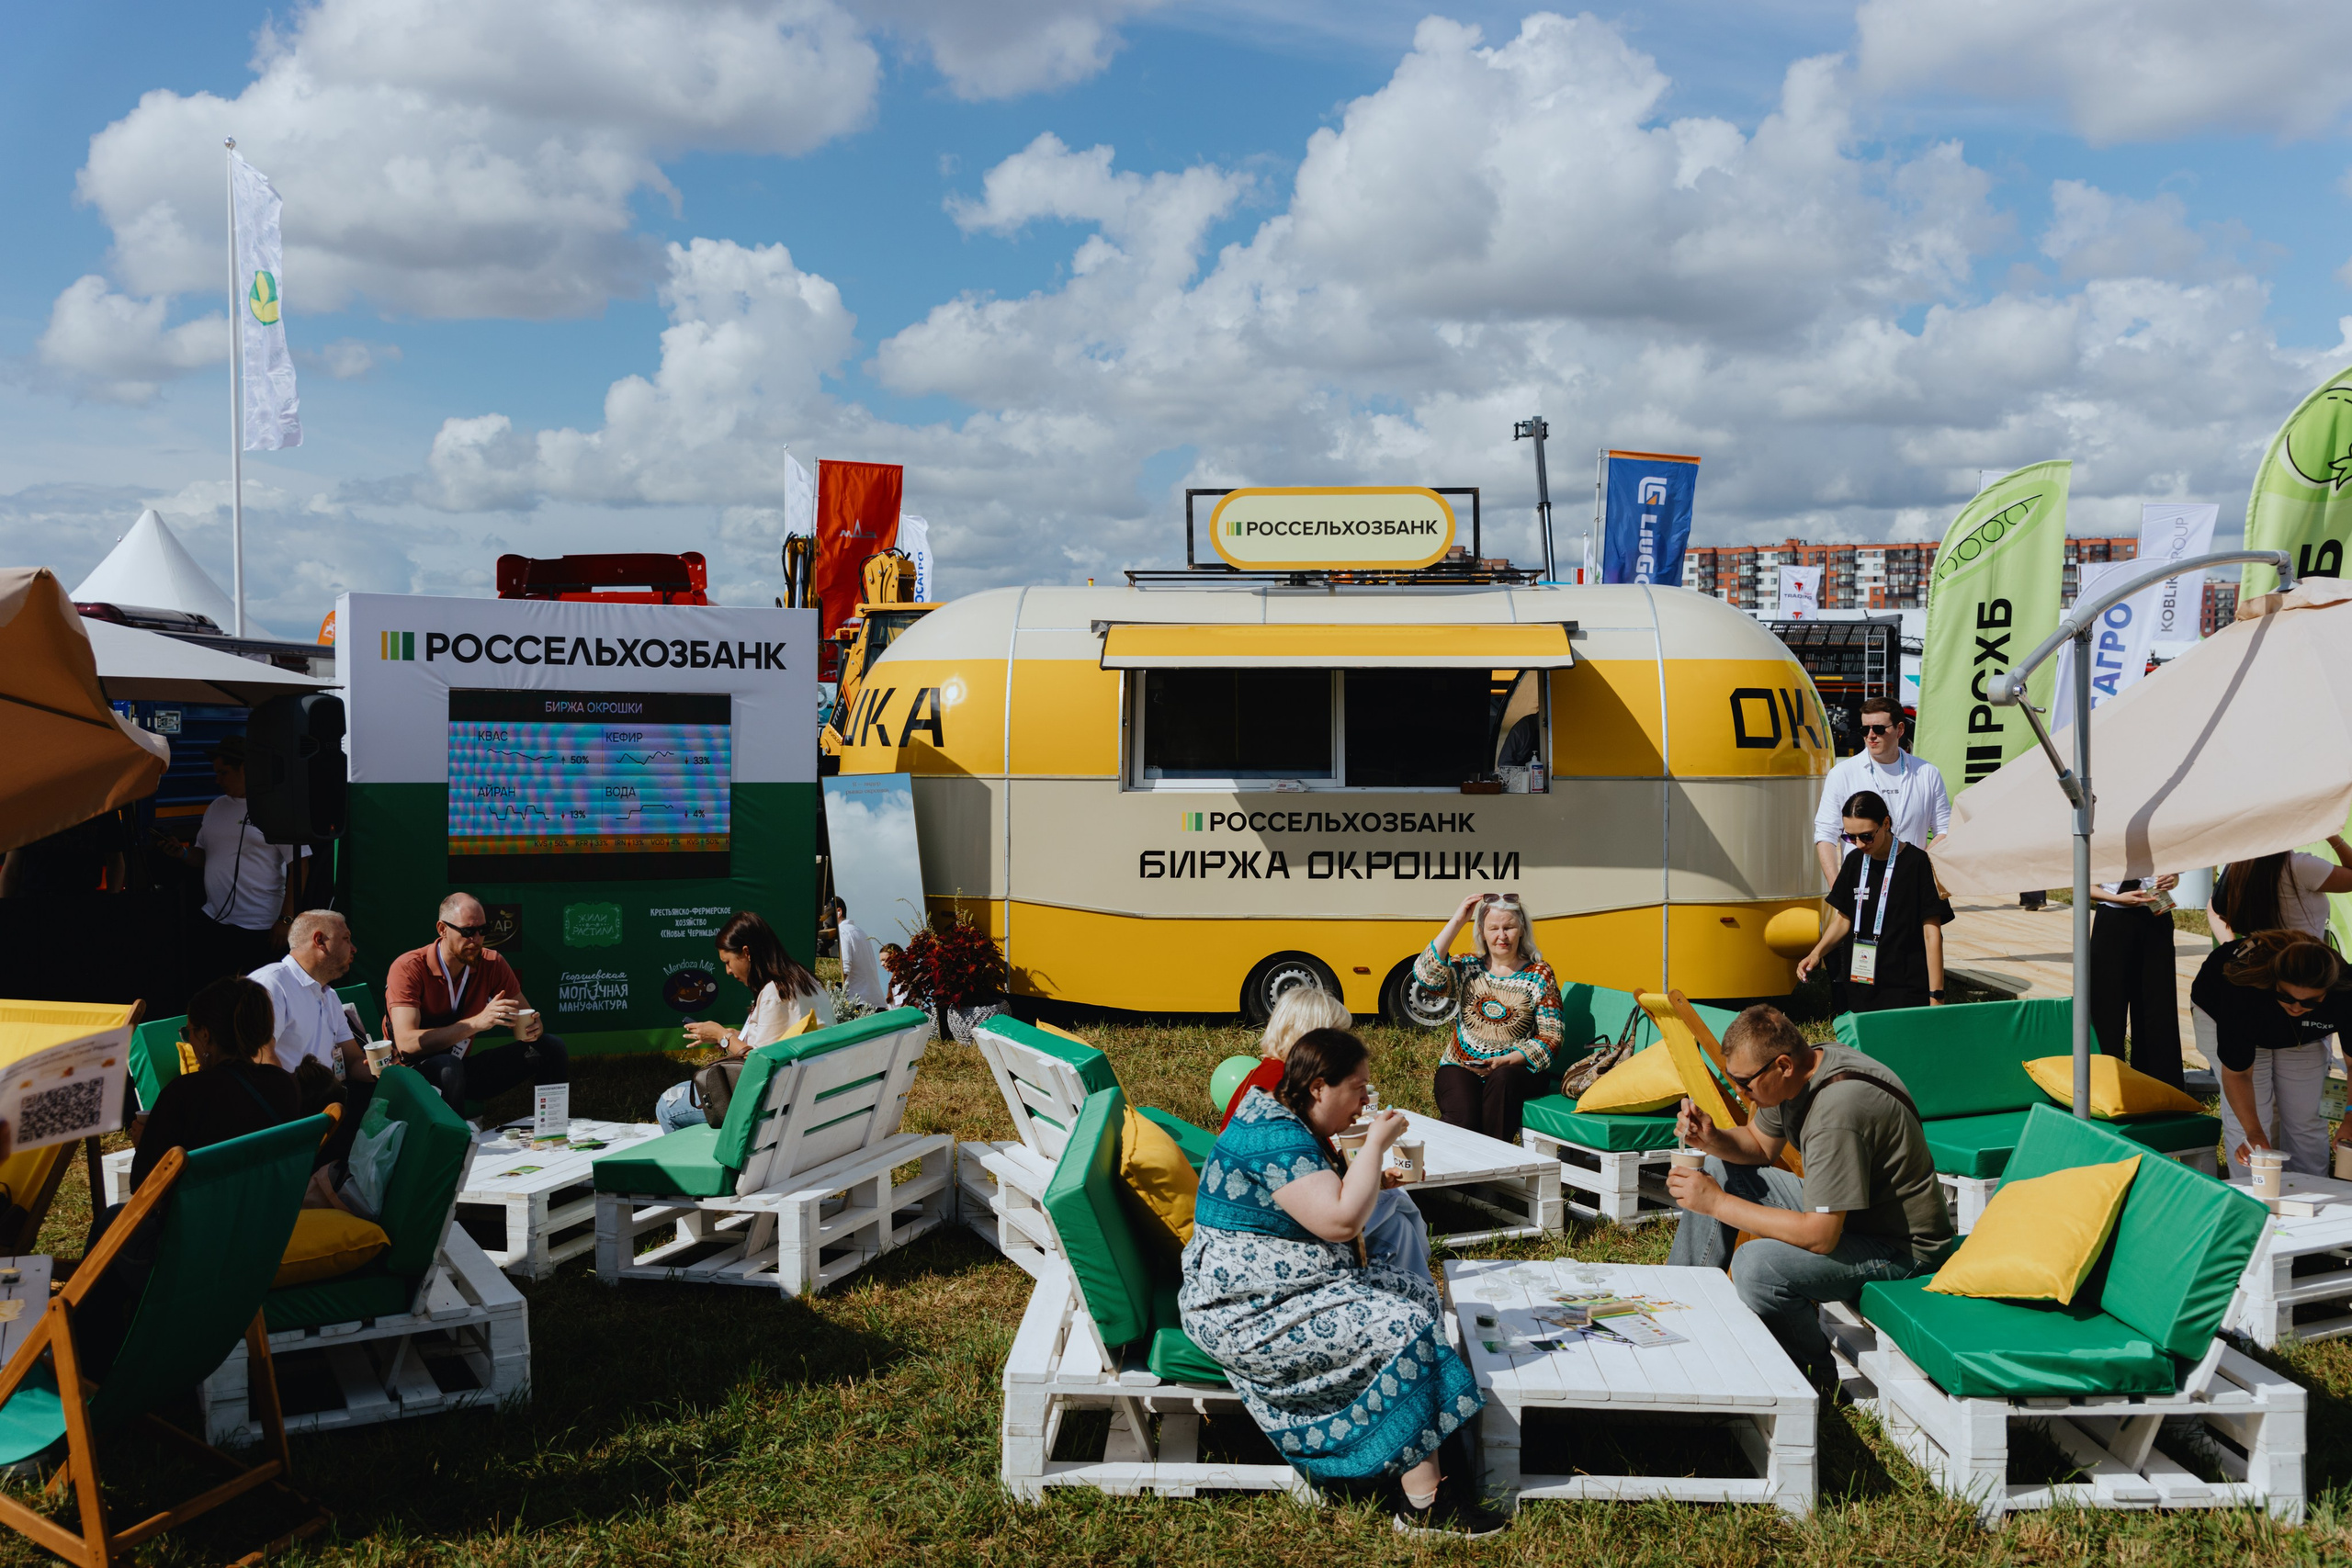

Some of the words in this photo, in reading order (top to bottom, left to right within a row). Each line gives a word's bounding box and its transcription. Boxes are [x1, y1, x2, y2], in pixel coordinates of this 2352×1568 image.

[1246, 519, 1438, 537] РОССЕЛЬХОЗБАНК
[2170, 517, 2189, 566] ROUP
[425, 632, 787, 671] РОССЕЛЬХОЗБАНК
[1968, 598, 2012, 734] РСХБ
[545, 701, 584, 714] БИРЖА
[587, 702, 643, 715] ОКРОШКИ
[478, 731, 508, 742] КВАС
[605, 732, 643, 743] КЕФИР
[571, 755, 589, 765] 50%
[693, 756, 710, 765] 33%
[478, 784, 516, 797] АЙРАН
[605, 787, 637, 799] ВОДА
[571, 810, 586, 819] 13%
[693, 809, 706, 818] 4%
[1210, 811, 1476, 833] РОССЕЛЬХОЗБАНК
[1139, 850, 1290, 880] БИРЖА
[1308, 850, 1521, 880] ОКРОШКИ
[650, 907, 731, 917] КРЕСТЬЯНСКО-ФЕРМЕРСКОЕ
[490, 919, 514, 932] АР
[675, 917, 707, 926] ХОЗЯЙСТВО
[662, 958, 698, 976] Mendoza
[699, 959, 716, 974] Milk
[559, 999, 628, 1012] МАНУФАКТУРА
